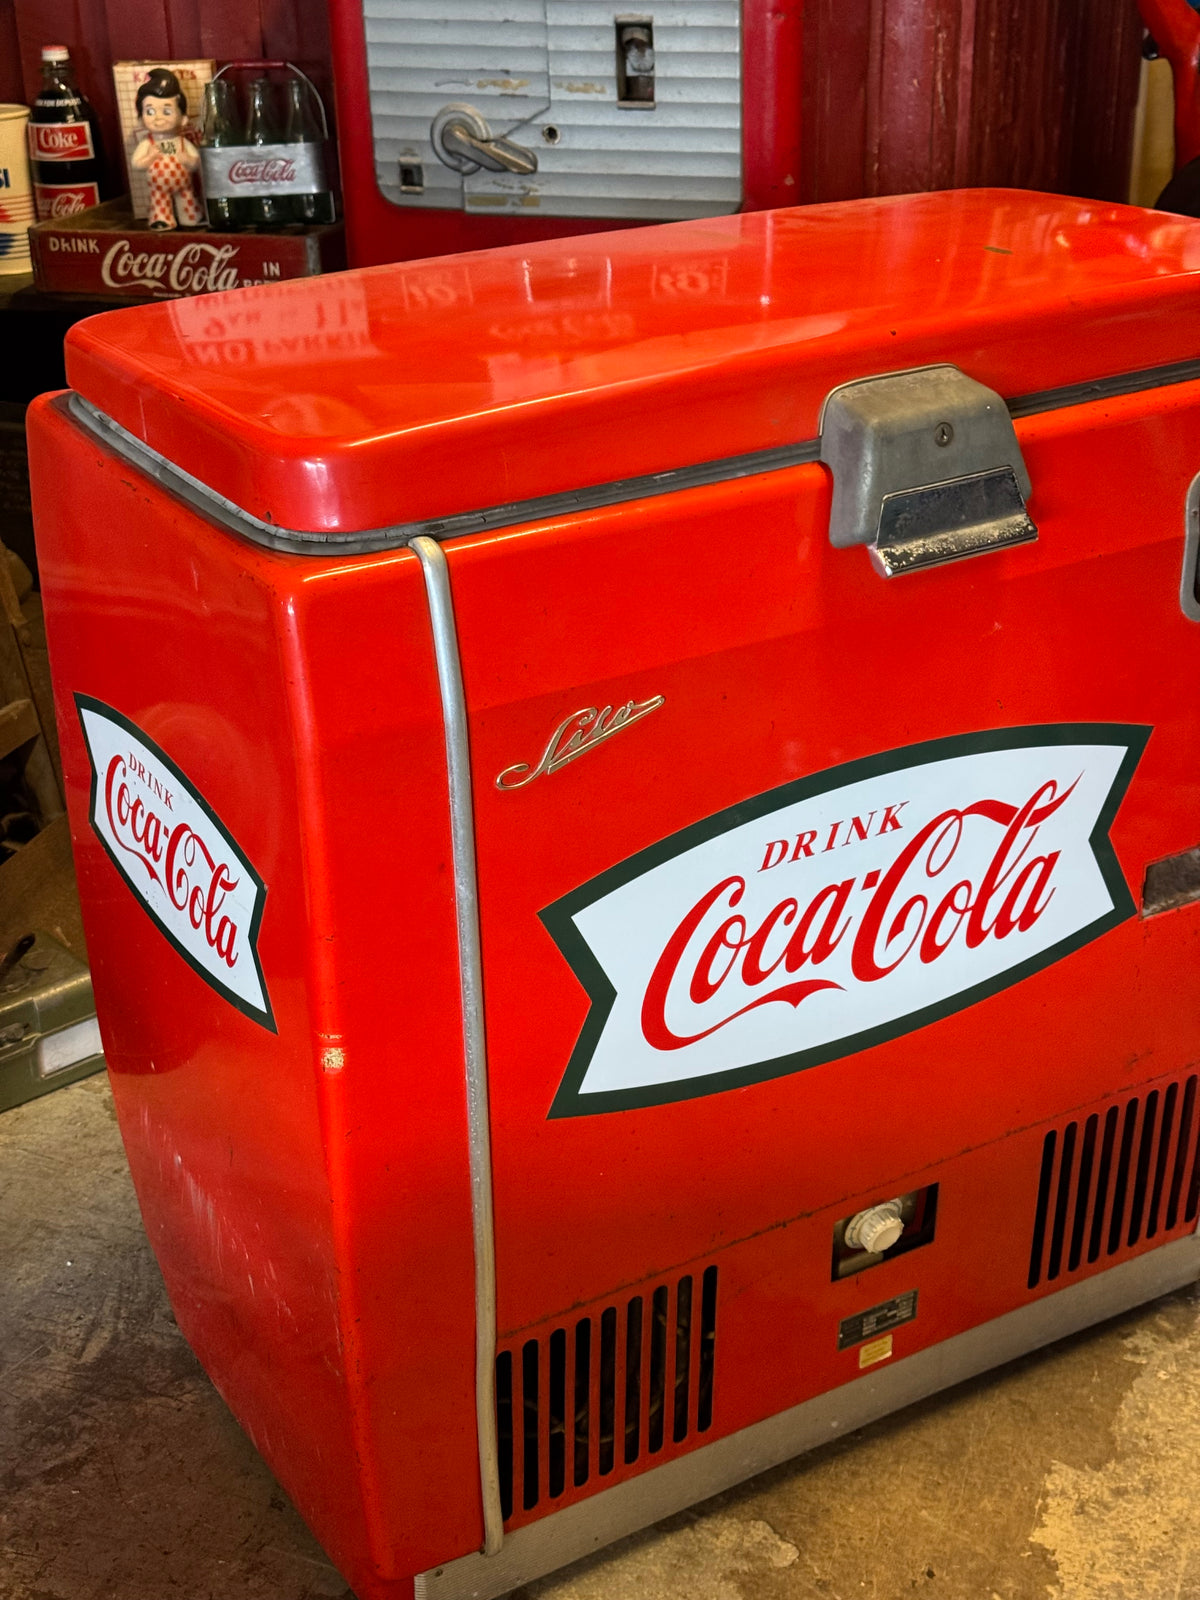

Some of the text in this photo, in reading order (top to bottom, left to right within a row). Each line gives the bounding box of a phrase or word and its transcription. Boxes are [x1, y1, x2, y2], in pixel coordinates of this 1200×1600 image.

[39, 128, 79, 149] Coke
[228, 158, 297, 185] Coca-Cola
[50, 236, 241, 291] DRINK Coca-Cola
[262, 261, 281, 277] IN
[128, 751, 174, 812] DRINK
[105, 754, 240, 968] Coca-Cola
[757, 800, 910, 872] DRINK
[641, 770, 1085, 1051] Coca-Cola
